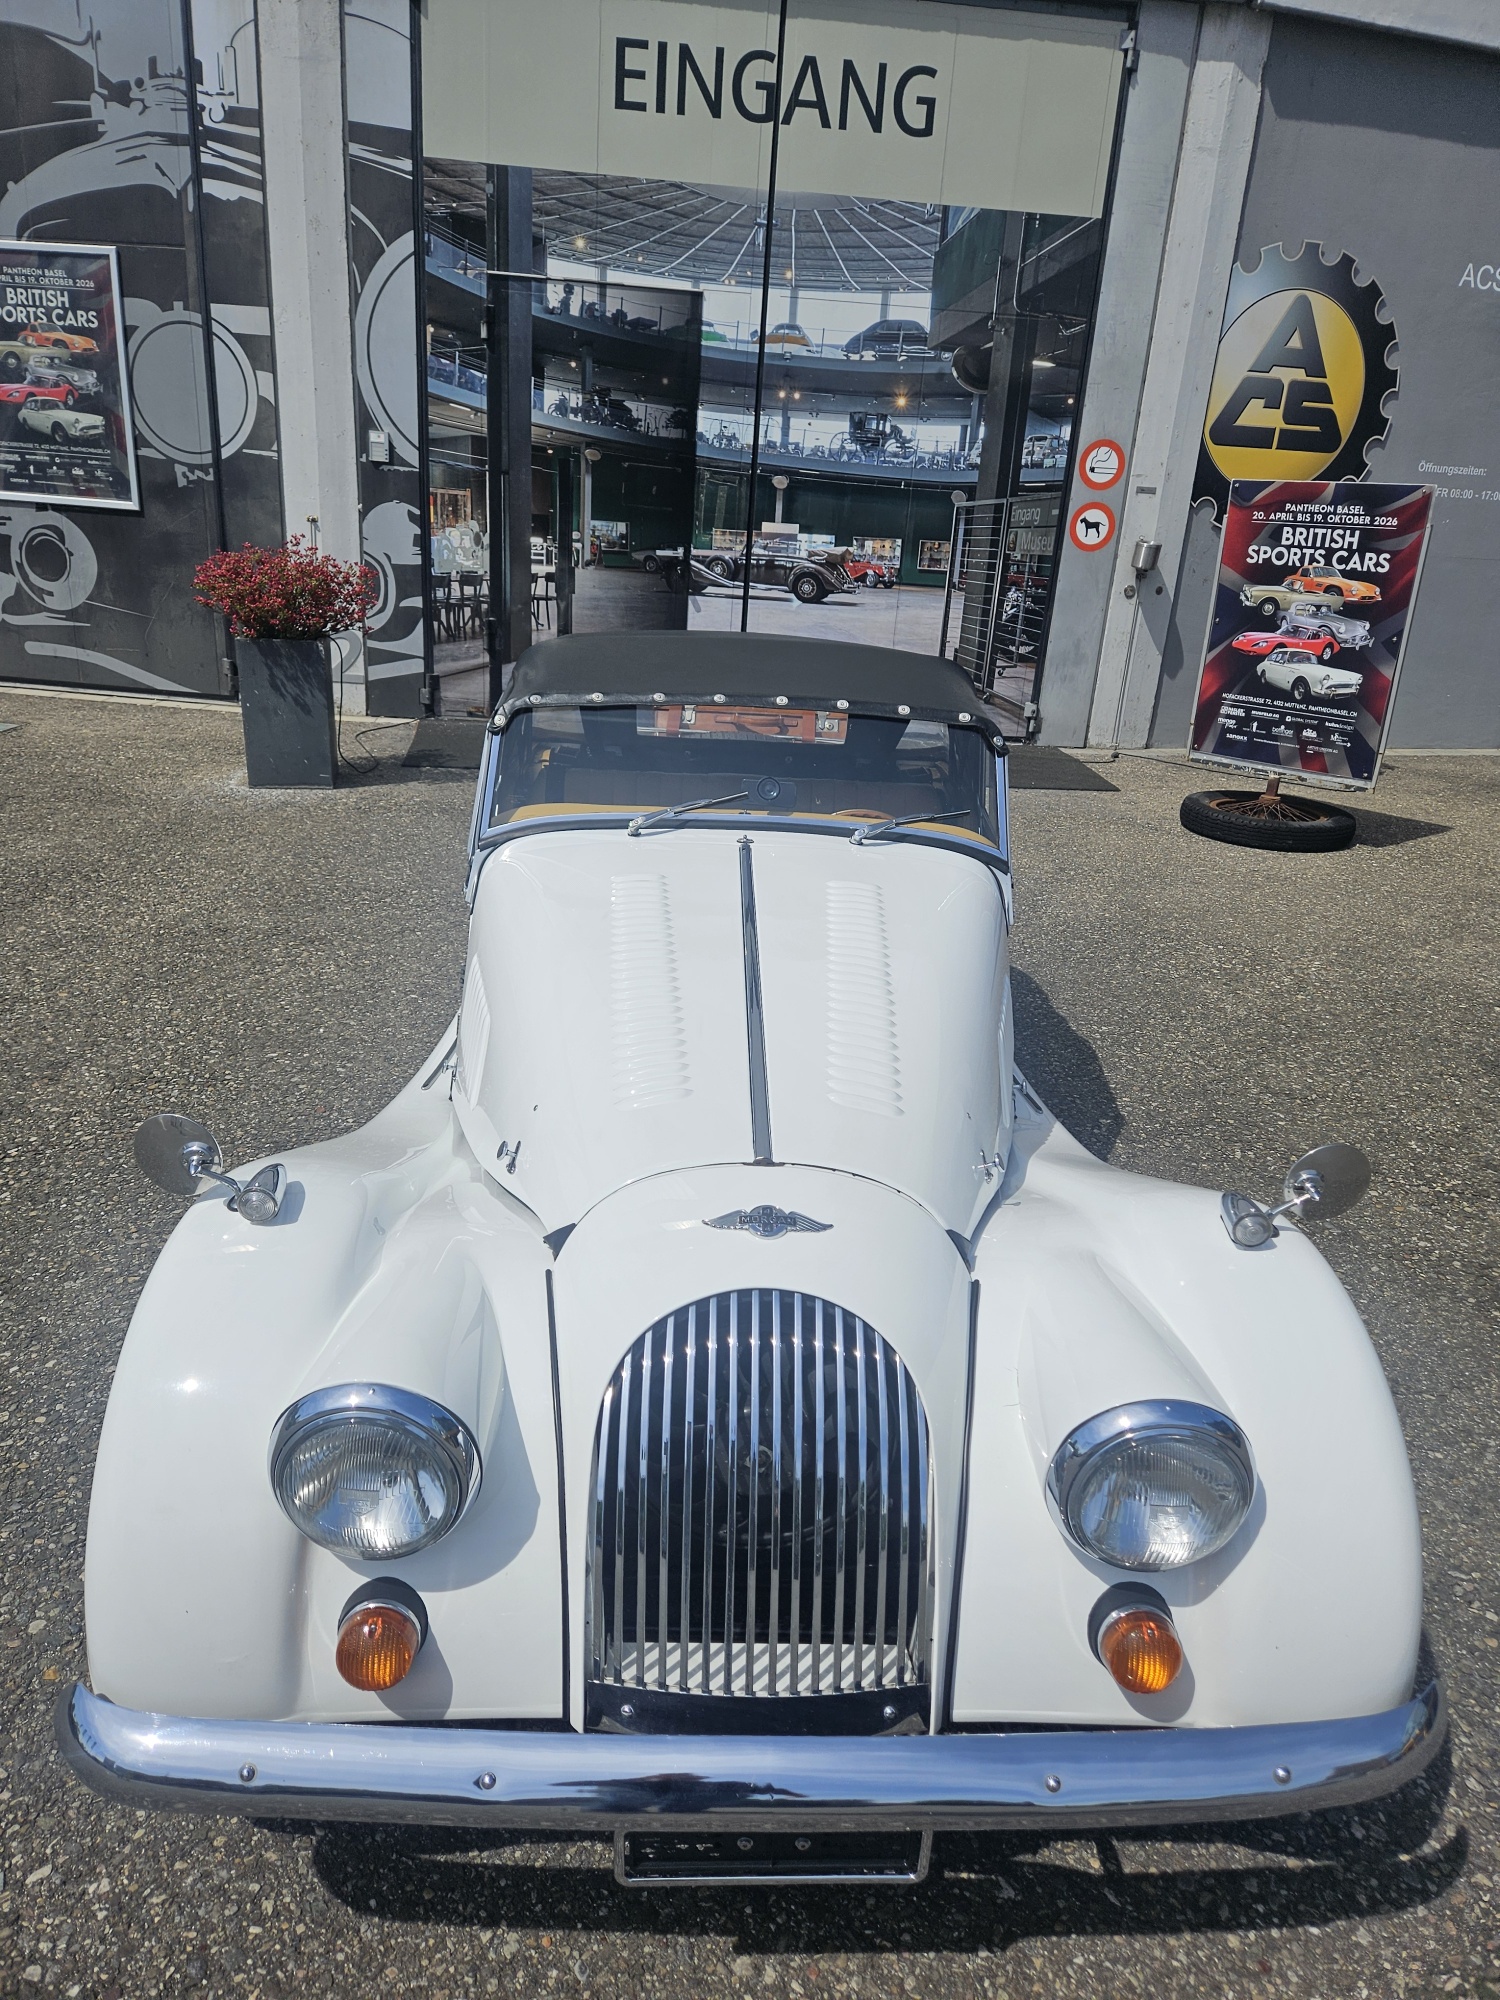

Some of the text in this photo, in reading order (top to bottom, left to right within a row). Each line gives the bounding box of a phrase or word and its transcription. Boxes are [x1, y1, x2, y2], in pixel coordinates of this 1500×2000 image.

[614, 36, 938, 138] EINGANG
[3, 266, 67, 277] PANTHEON BASEL
[0, 274, 95, 288] RIL BIS 19. OKTOBER 2026
[6, 287, 70, 308] BRITISH
[0, 305, 99, 328] ORTS CARS
[1418, 460, 1488, 476] Öffnungszeiten:
[1436, 487, 1449, 498] FR
[1450, 488, 1473, 499] 08:00
[1011, 505, 1041, 526] Eingang
[1285, 503, 1365, 514] PANTHEON BASEL
[1252, 511, 1398, 526] 20. APRIL BIS 19. OKTOBER 2026
[1281, 526, 1360, 550] BRITISH
[1246, 545, 1391, 573] SPORTS CARS
[741, 1215, 795, 1225] MORGAN
